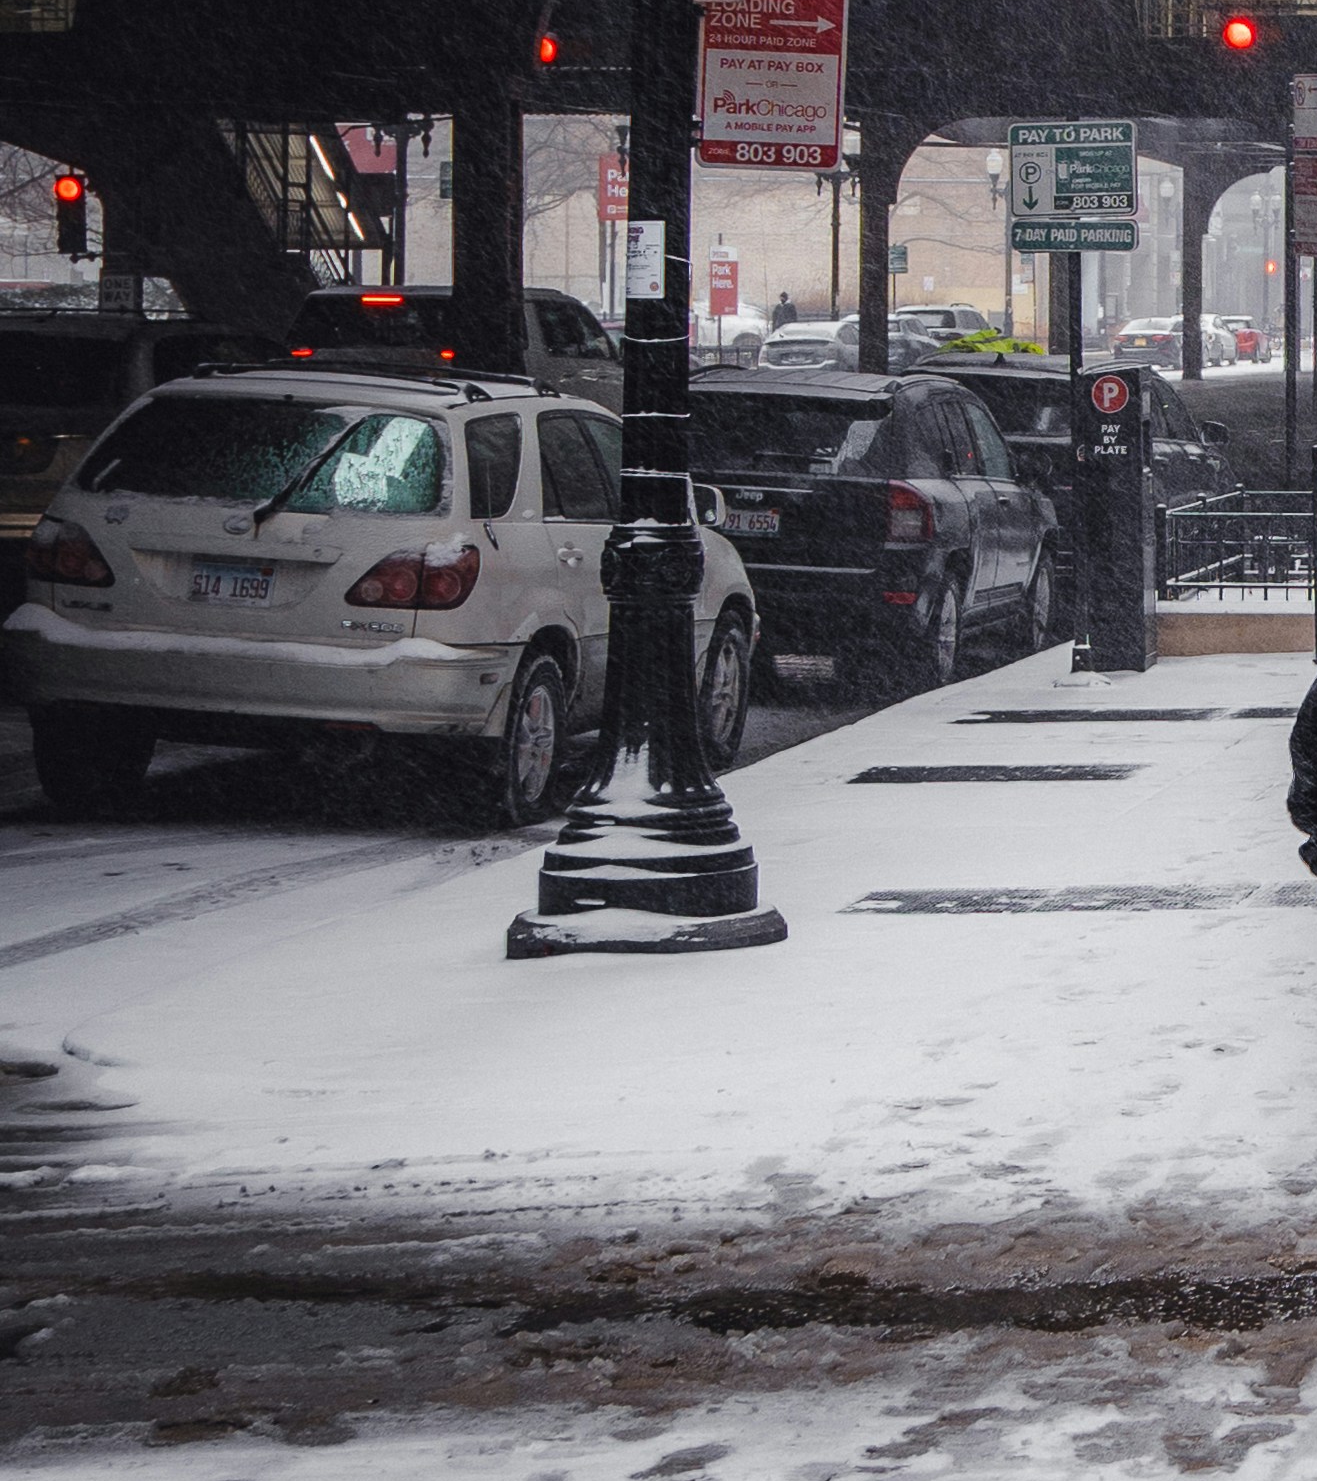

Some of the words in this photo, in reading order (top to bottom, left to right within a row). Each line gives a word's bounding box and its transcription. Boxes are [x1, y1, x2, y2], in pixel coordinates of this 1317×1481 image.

[710, 13, 762, 28] ZONE
[709, 34, 721, 43] 24
[724, 35, 756, 45] HOUR
[759, 36, 784, 47] PAID
[787, 38, 817, 48] ZONE
[720, 58, 747, 70] PAY
[748, 59, 765, 70] AT
[767, 61, 792, 72] PAY
[796, 62, 824, 73] BOX
[725, 121, 732, 130] A
[735, 122, 773, 132] MOBILE
[775, 124, 794, 133] PAY
[796, 124, 817, 135] APP
[1019, 129, 1049, 143] PAY
[1054, 128, 1075, 142] TO
[1080, 127, 1124, 141] PARK
[736, 143, 776, 162] 803
[782, 145, 822, 164] 903
[1073, 196, 1099, 208] 803
[1102, 195, 1128, 208] 903
[1050, 229, 1077, 242] PAID
[1081, 228, 1132, 243] PARKING
[712, 263, 731, 276] Park
[104, 277, 131, 291] ONE
[104, 290, 132, 303] WAY
[1101, 424, 1121, 433] PAY
[1103, 435, 1117, 444] BY
[1094, 445, 1128, 455] PLATE
[735, 487, 764, 502] Jeep
[748, 514, 776, 531] 6554
[229, 577, 271, 600] 1699
